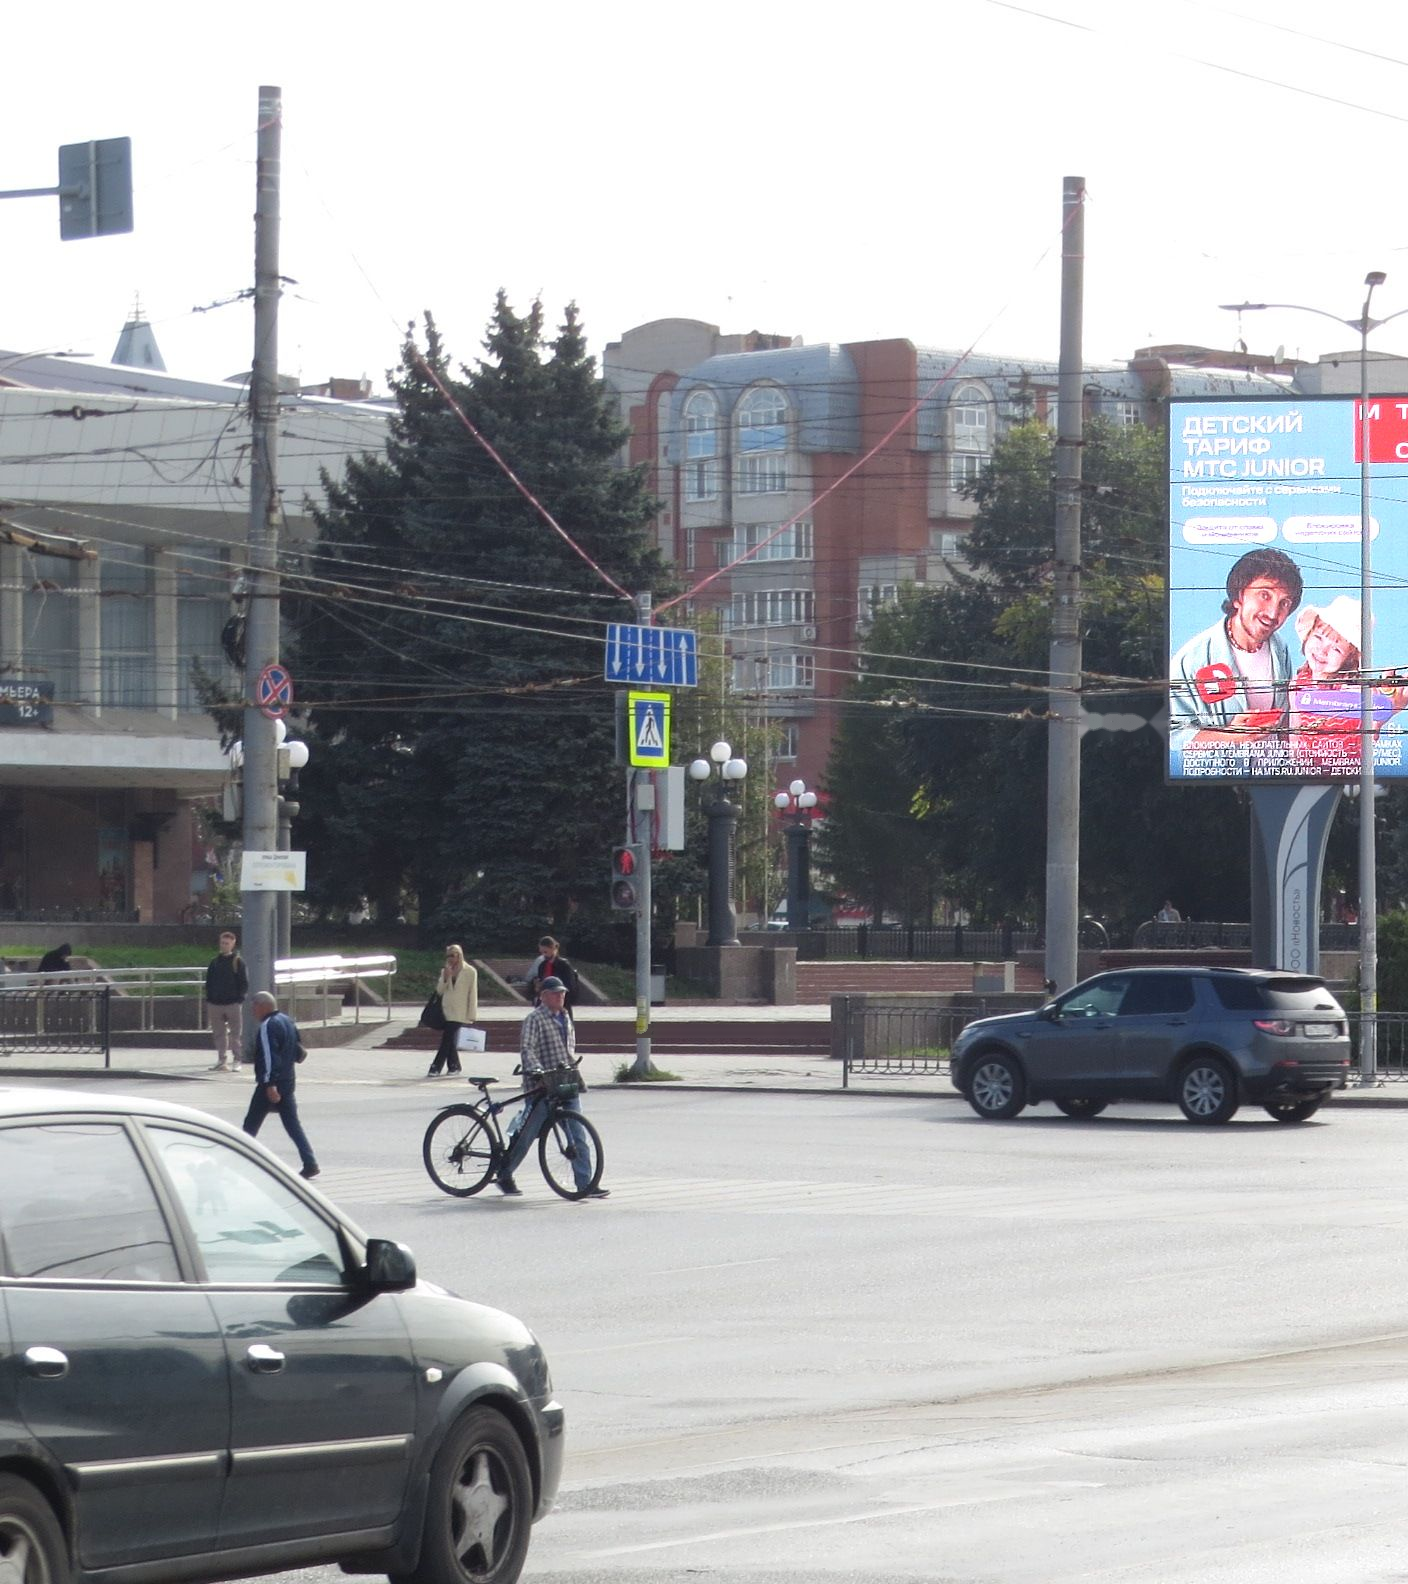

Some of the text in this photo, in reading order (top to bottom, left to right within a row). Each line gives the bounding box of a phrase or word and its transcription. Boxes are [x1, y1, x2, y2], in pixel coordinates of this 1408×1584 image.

[1182, 410, 1303, 437] ДЕТСКИЙ
[1183, 437, 1271, 456] ТАРИФ
[1183, 457, 1326, 478] МТС JUNIOR
[1182, 484, 1264, 497] Подключайте
[1273, 485, 1341, 496] сервисами
[1182, 497, 1267, 507] безопасности
[19, 705, 39, 718] 12+
[1183, 740, 1236, 749] БЛОКИРОВКА
[1183, 750, 1219, 758] СЕРВИСА
[1183, 758, 1235, 767] ДОСТУПНОГО
[1258, 758, 1313, 767] ПРИЛОЖЕНИИ
[1321, 757, 1361, 766] MEMBRAN
[1183, 767, 1242, 776] ПОДРОБНОСТИ
[1331, 766, 1362, 776] ДЕТСКИ
[1290, 948, 1301, 974] ОО
